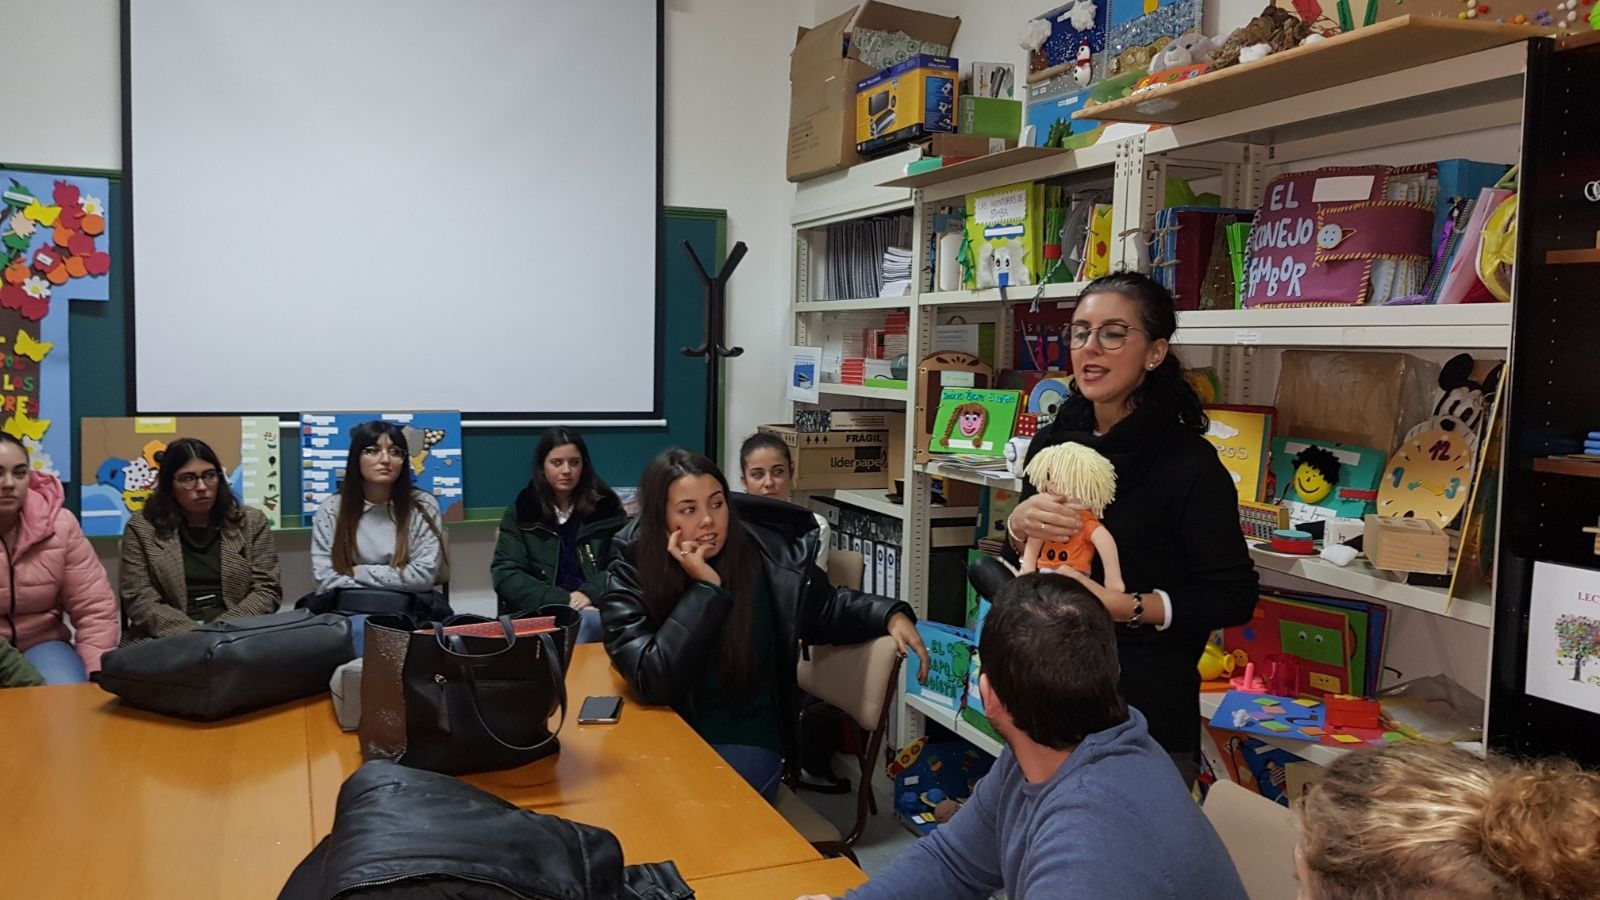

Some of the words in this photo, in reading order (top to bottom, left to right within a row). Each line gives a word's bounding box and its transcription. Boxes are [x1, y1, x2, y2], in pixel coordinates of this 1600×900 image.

[1270, 182, 1299, 211] EL
[1254, 217, 1314, 252] CONEJO
[3, 374, 33, 392] LOS
[1429, 440, 1451, 461] 12
[1445, 477, 1461, 499] 3
